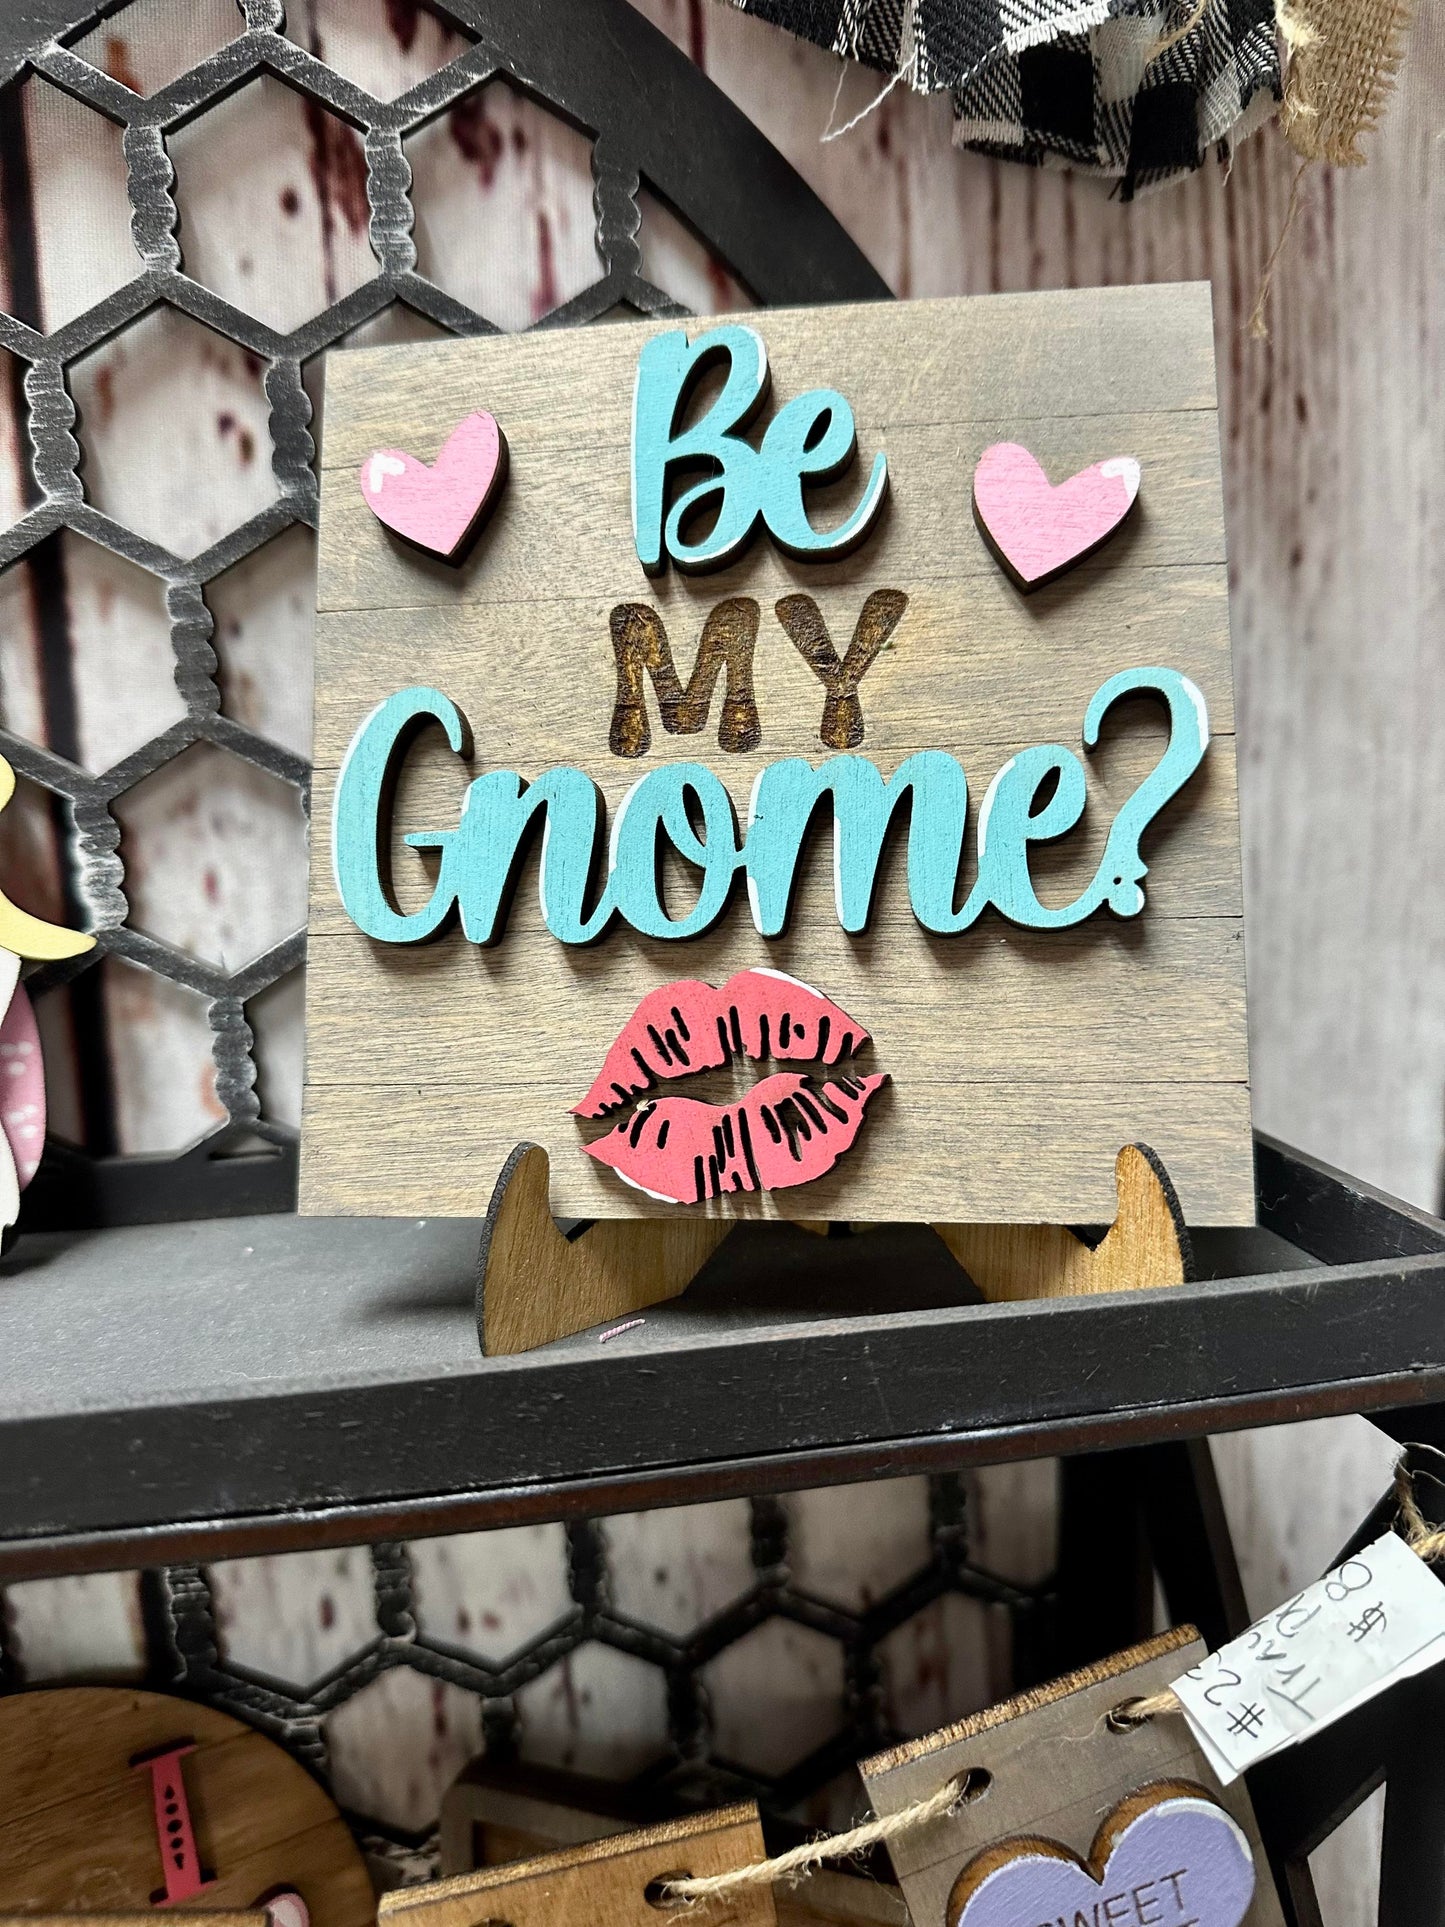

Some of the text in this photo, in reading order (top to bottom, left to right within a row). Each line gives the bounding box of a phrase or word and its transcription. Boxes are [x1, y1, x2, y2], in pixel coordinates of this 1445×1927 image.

[630, 324, 887, 572] Be
[608, 588, 910, 758] MY
[330, 666, 1211, 948] Gnome?
[1037, 1868, 1188, 1927] WEET
